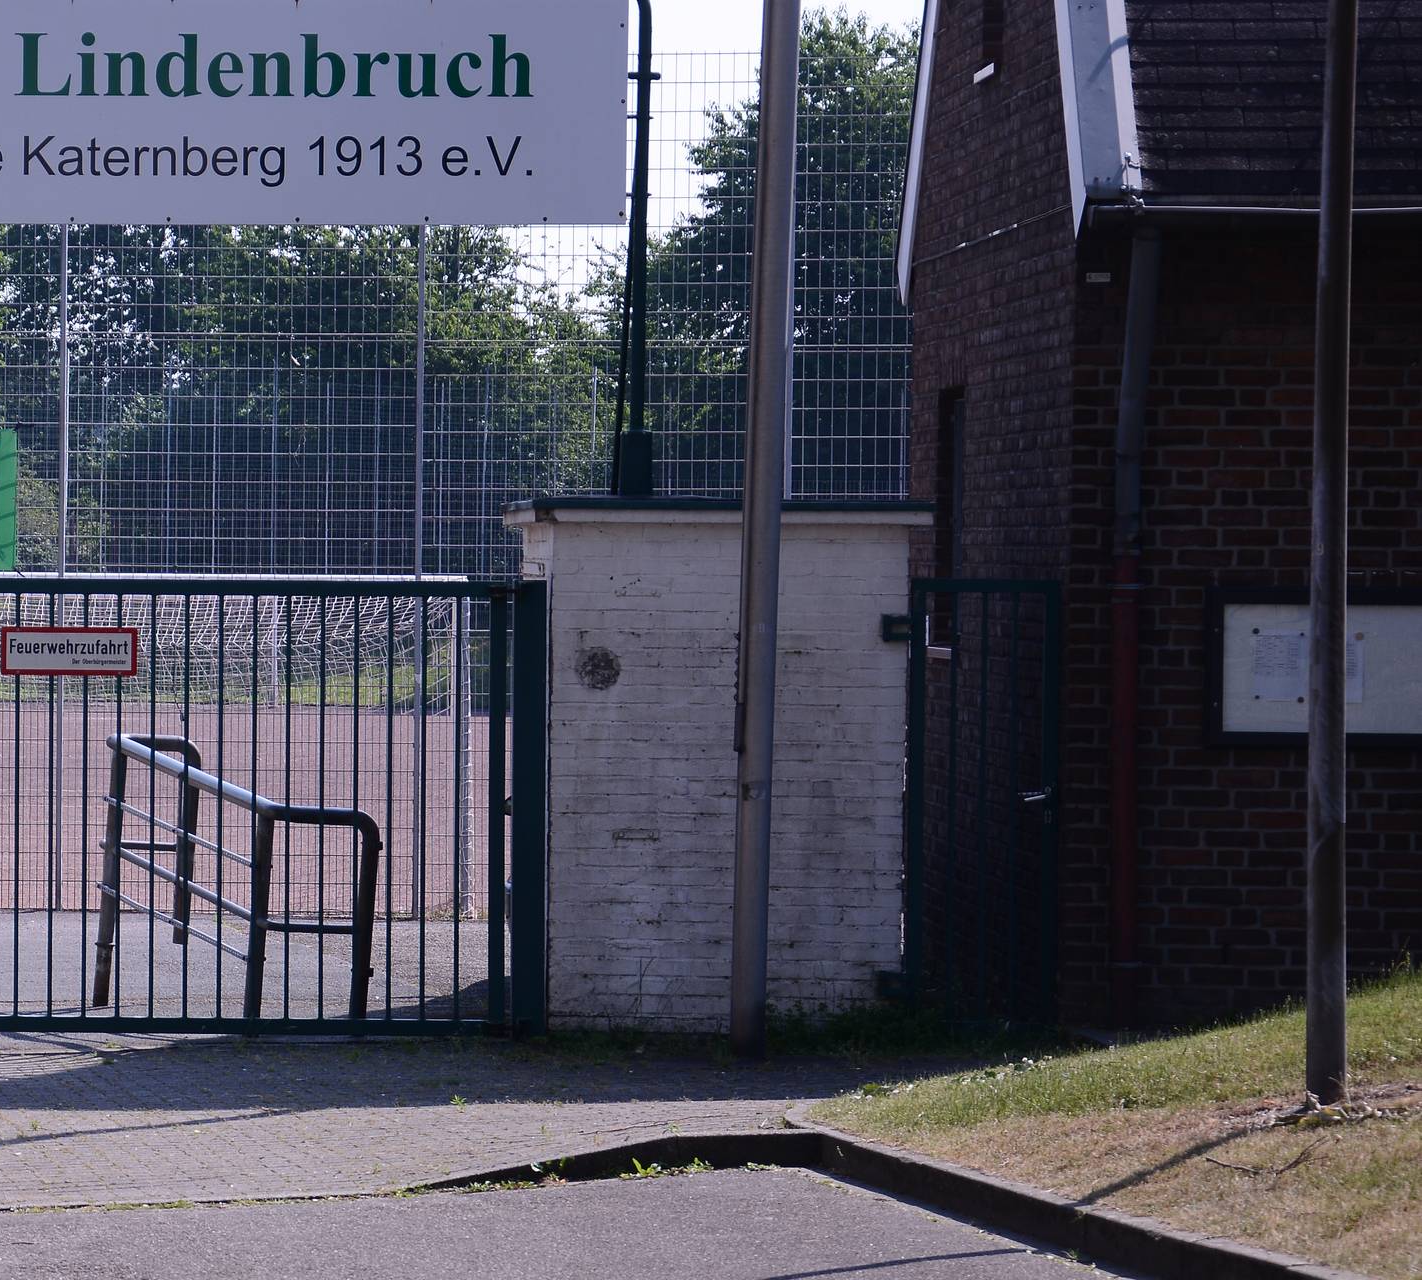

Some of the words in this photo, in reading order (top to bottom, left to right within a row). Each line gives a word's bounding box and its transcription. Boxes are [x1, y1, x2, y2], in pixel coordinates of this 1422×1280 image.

[14, 31, 534, 98] Lindenbruch
[22, 135, 286, 188] Katernberg
[308, 135, 423, 178] 1913
[441, 135, 533, 178] e.V.
[9, 638, 129, 655] Feuerwehrzufahrt
